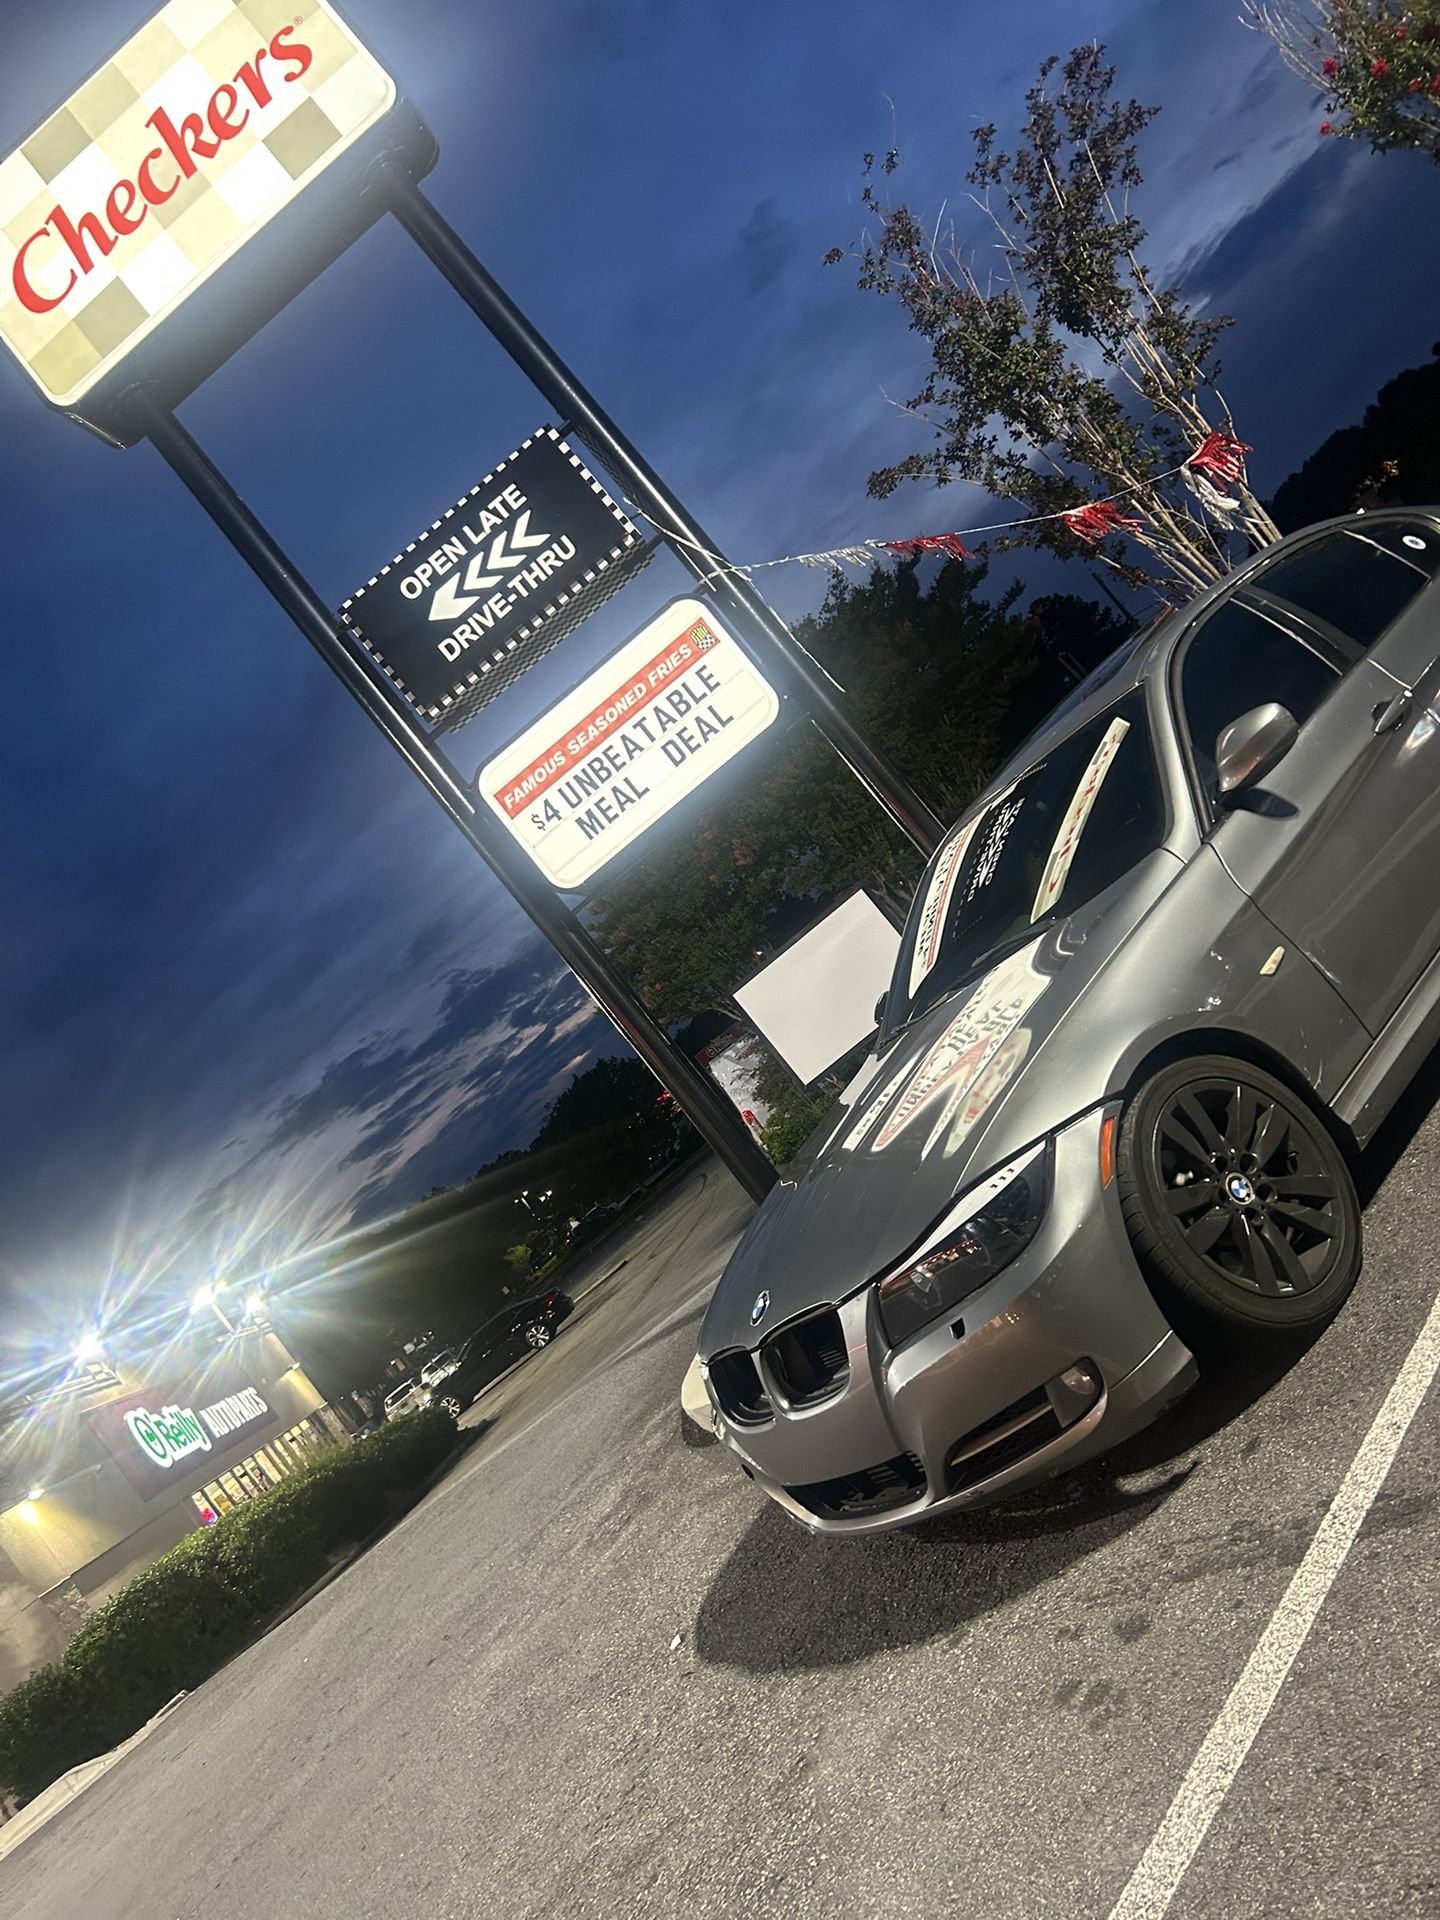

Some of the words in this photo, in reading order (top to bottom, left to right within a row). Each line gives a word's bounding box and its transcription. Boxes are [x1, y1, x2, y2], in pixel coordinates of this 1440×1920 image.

[12, 25, 313, 313] Checkers
[399, 535, 468, 600] OPEN
[462, 483, 527, 545] LATE
[436, 534, 577, 662] DRIVE-THRU
[503, 751, 566, 810] FAMOUS
[567, 682, 647, 756] SEASONED
[647, 642, 693, 688] FRIES
[530, 798, 562, 831] $4
[557, 664, 721, 810] UNBEATABLE
[574, 776, 650, 841] MEAL
[660, 705, 734, 768] DEAL
[128, 1408, 210, 1464] O'Reilly
